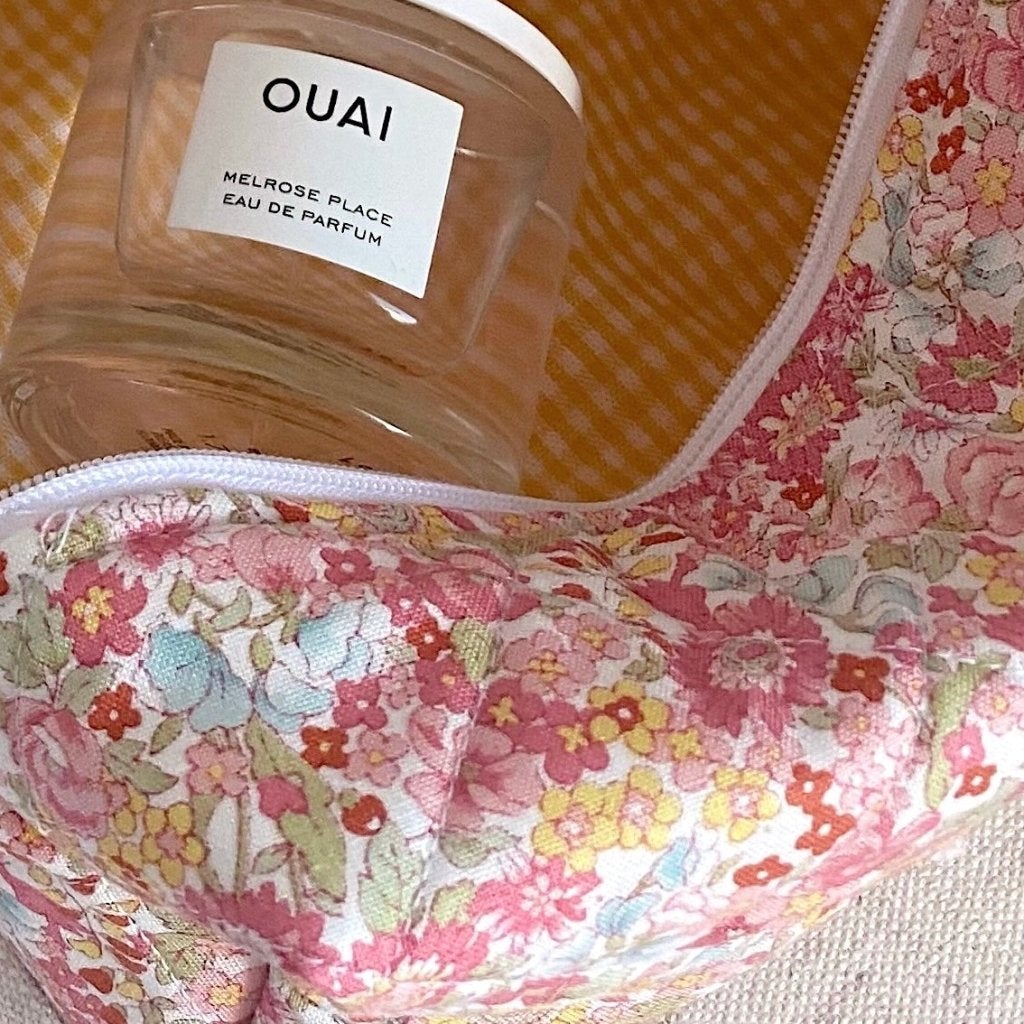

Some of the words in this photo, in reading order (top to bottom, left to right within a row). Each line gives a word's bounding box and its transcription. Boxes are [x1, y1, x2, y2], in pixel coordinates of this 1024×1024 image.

[262, 77, 393, 142] OUAI
[222, 192, 261, 210] EAU
[268, 200, 295, 219] DE
[301, 209, 382, 247] PARFUM
[223, 170, 321, 202] MELROSE
[328, 193, 393, 228] PLACE
